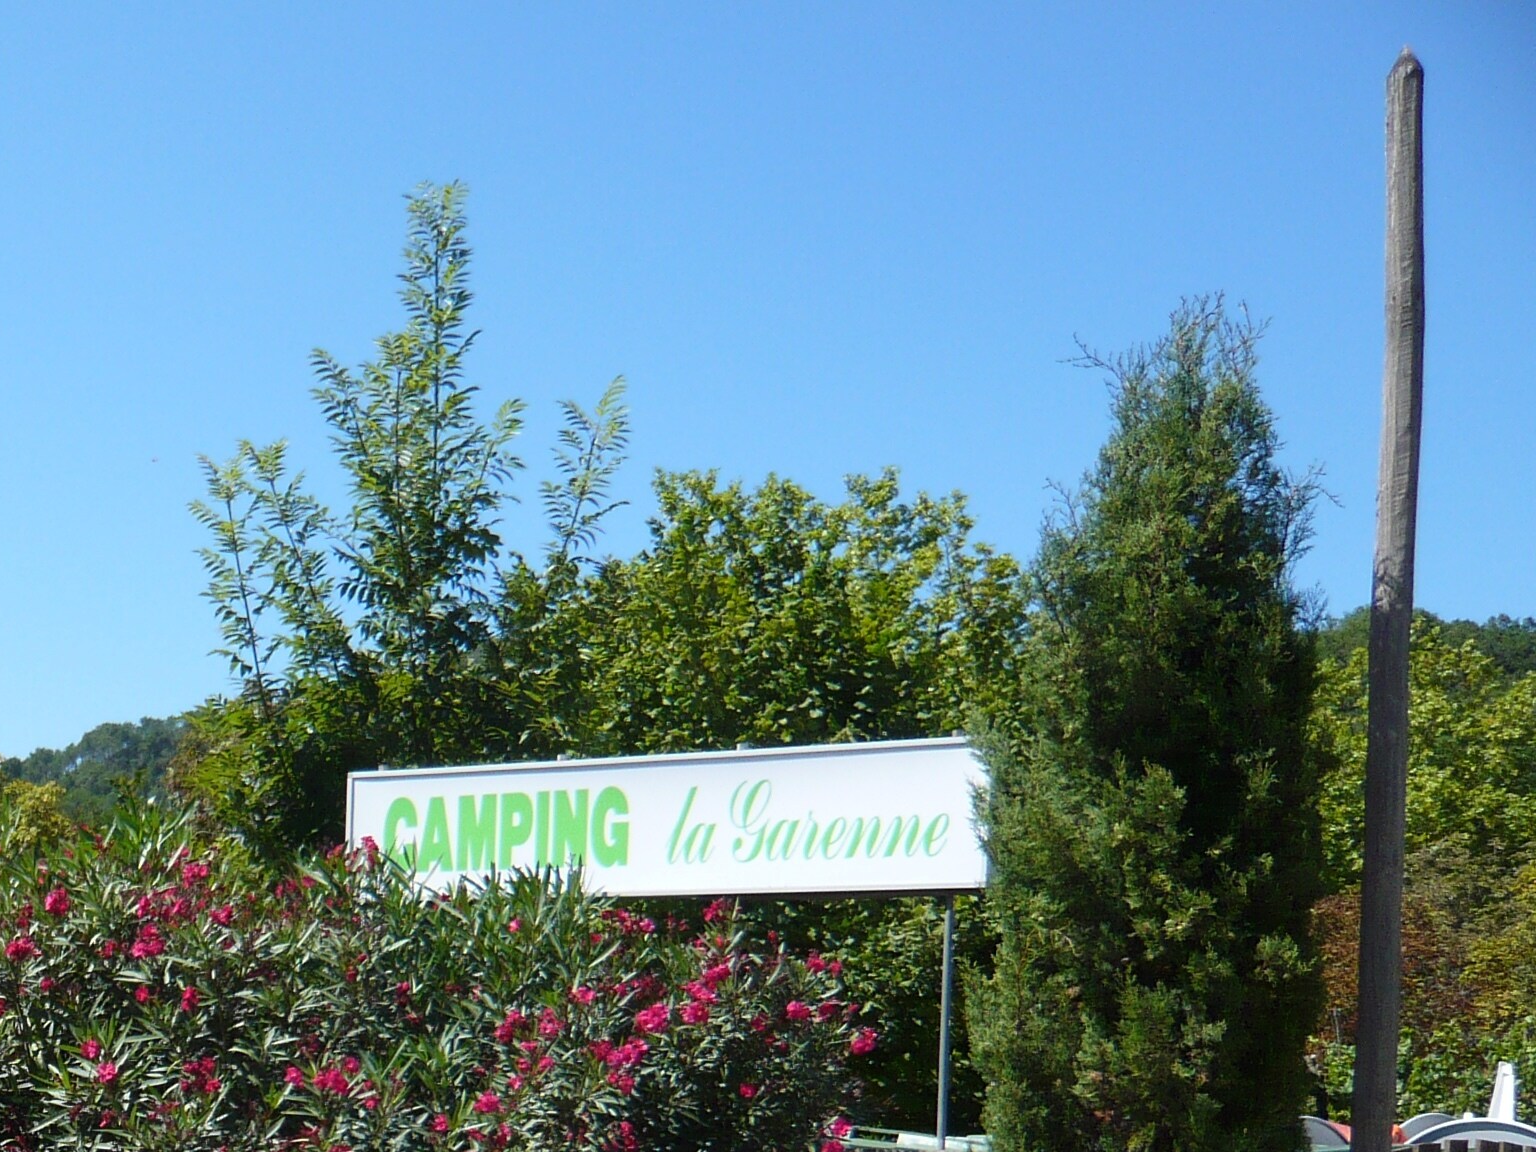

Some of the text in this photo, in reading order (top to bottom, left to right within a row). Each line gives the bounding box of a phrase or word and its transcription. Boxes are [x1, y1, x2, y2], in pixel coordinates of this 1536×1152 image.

[382, 778, 950, 874] CAMPING la Garenne
